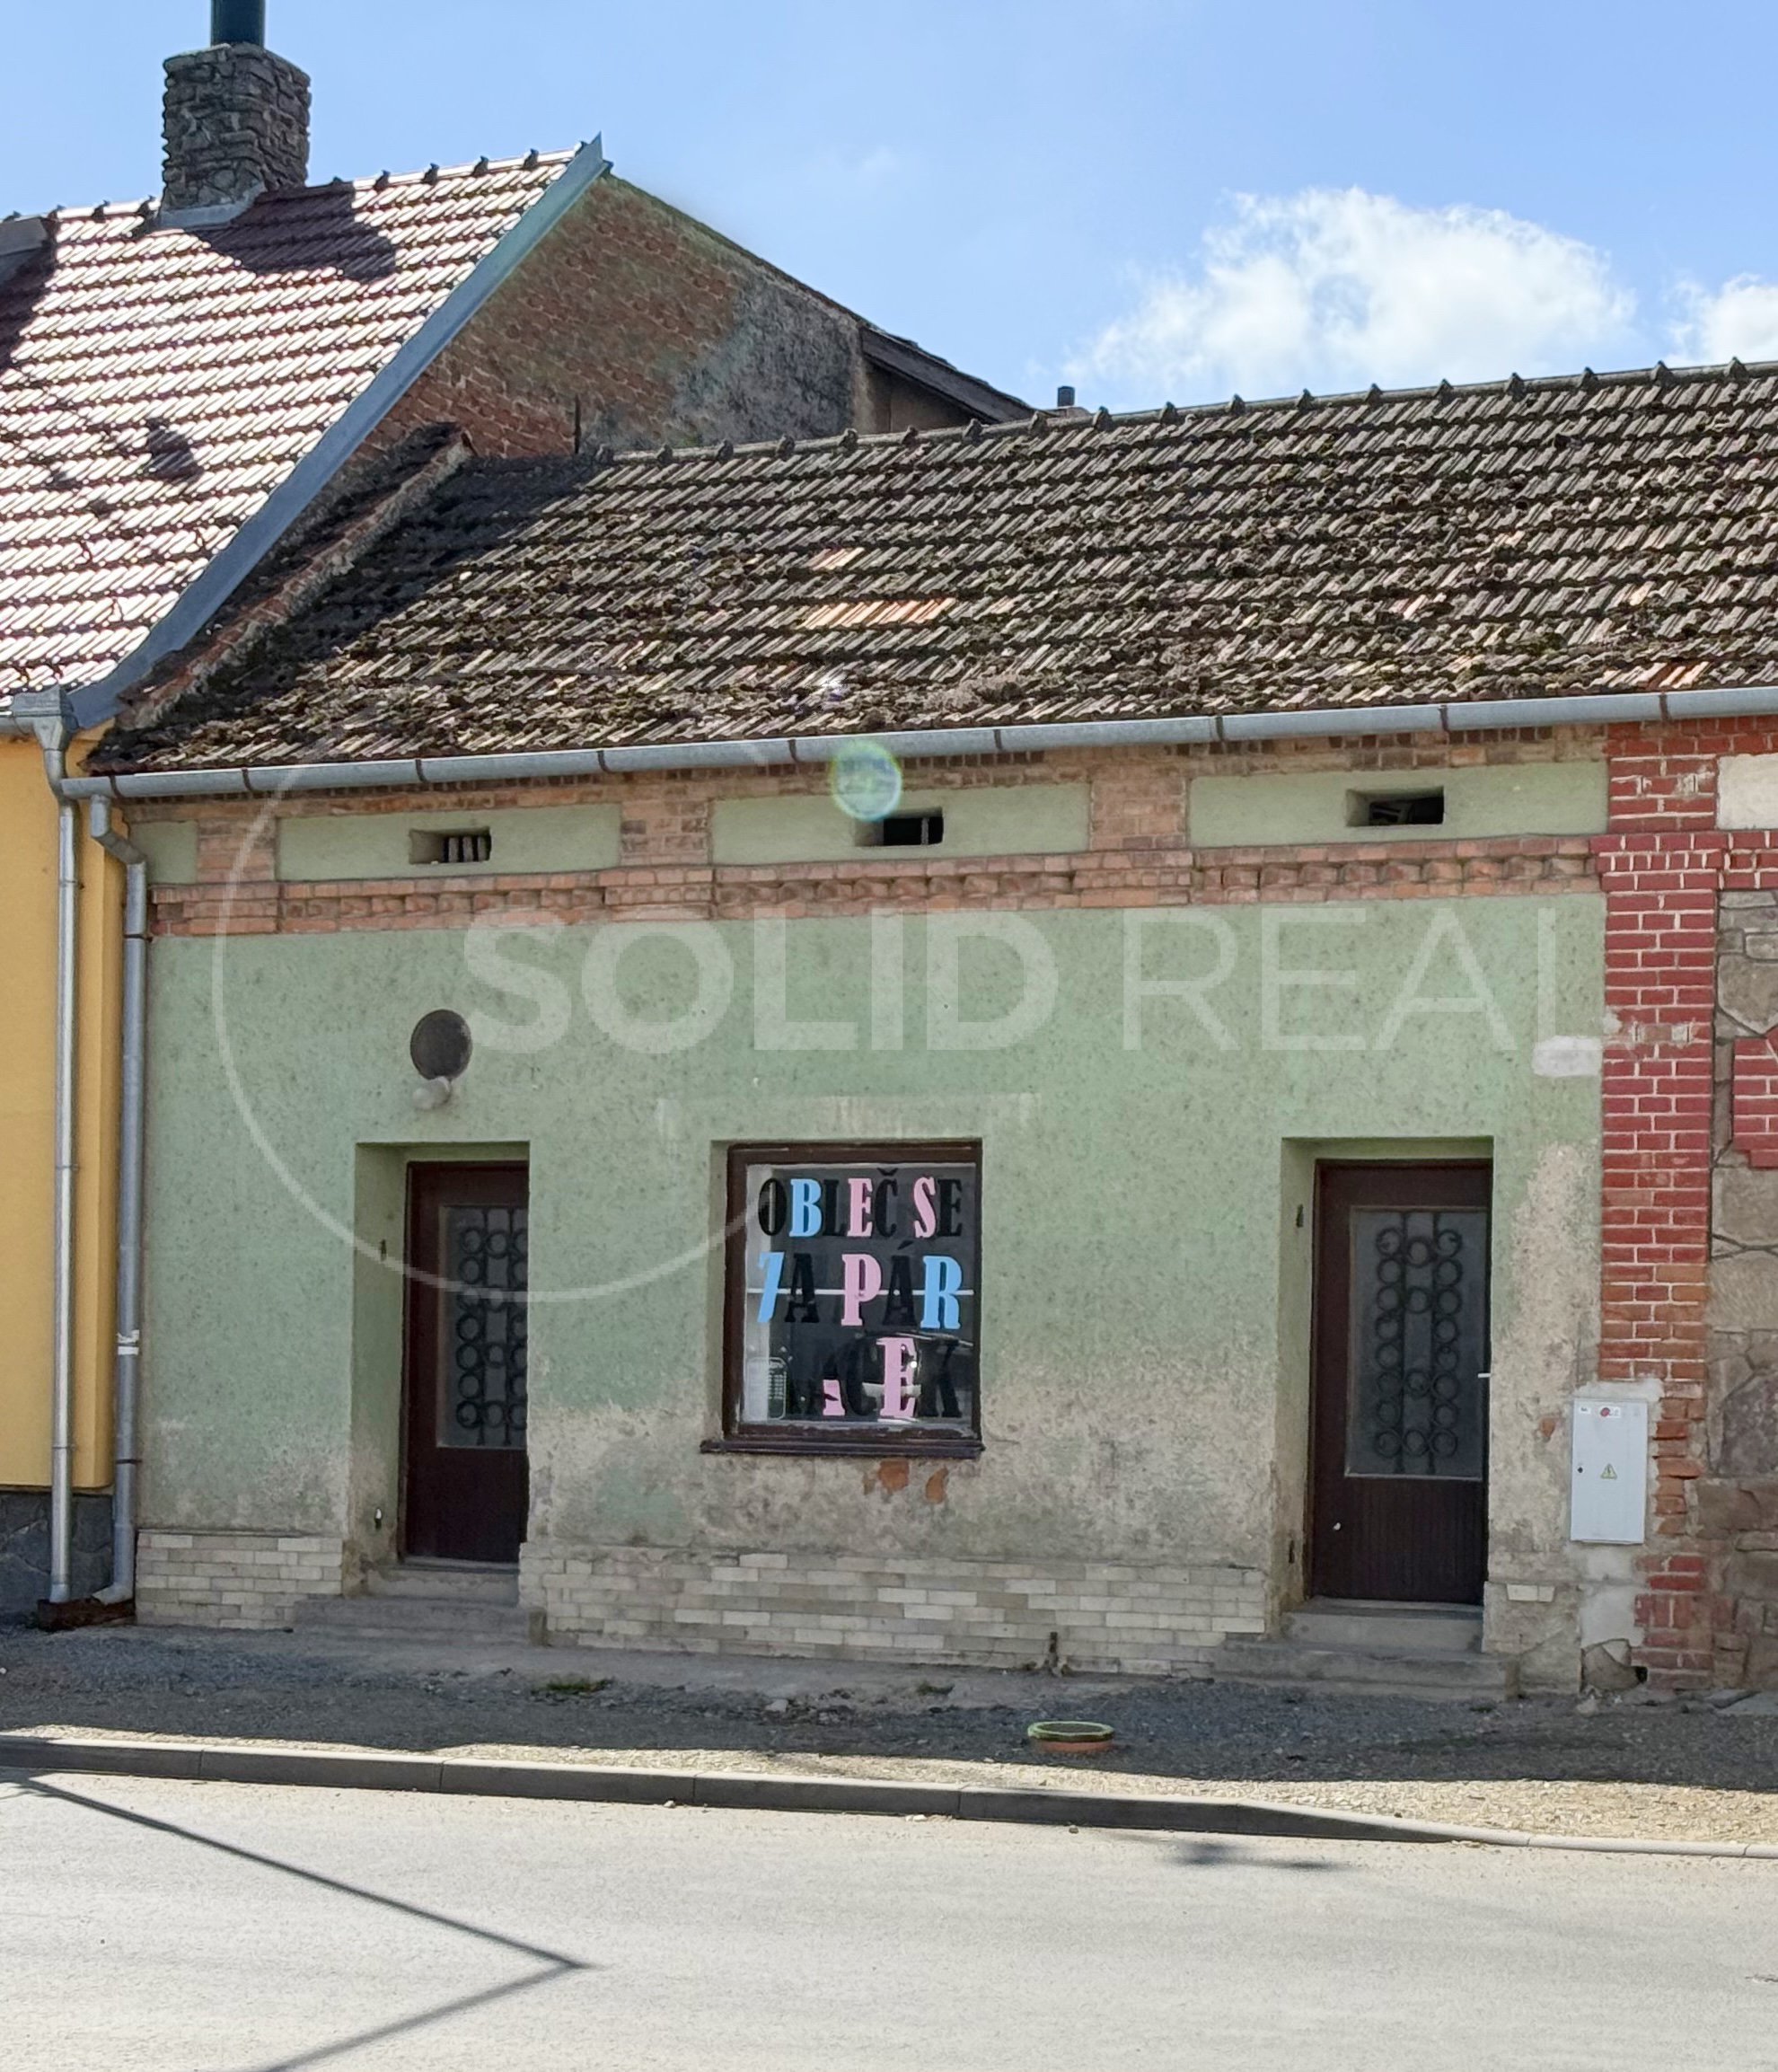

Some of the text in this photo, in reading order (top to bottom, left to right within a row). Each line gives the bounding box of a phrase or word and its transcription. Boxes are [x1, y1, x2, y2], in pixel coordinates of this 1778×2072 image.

[757, 1168, 963, 1239] OBLEČ SE
[841, 1239, 963, 1329] PÁR
